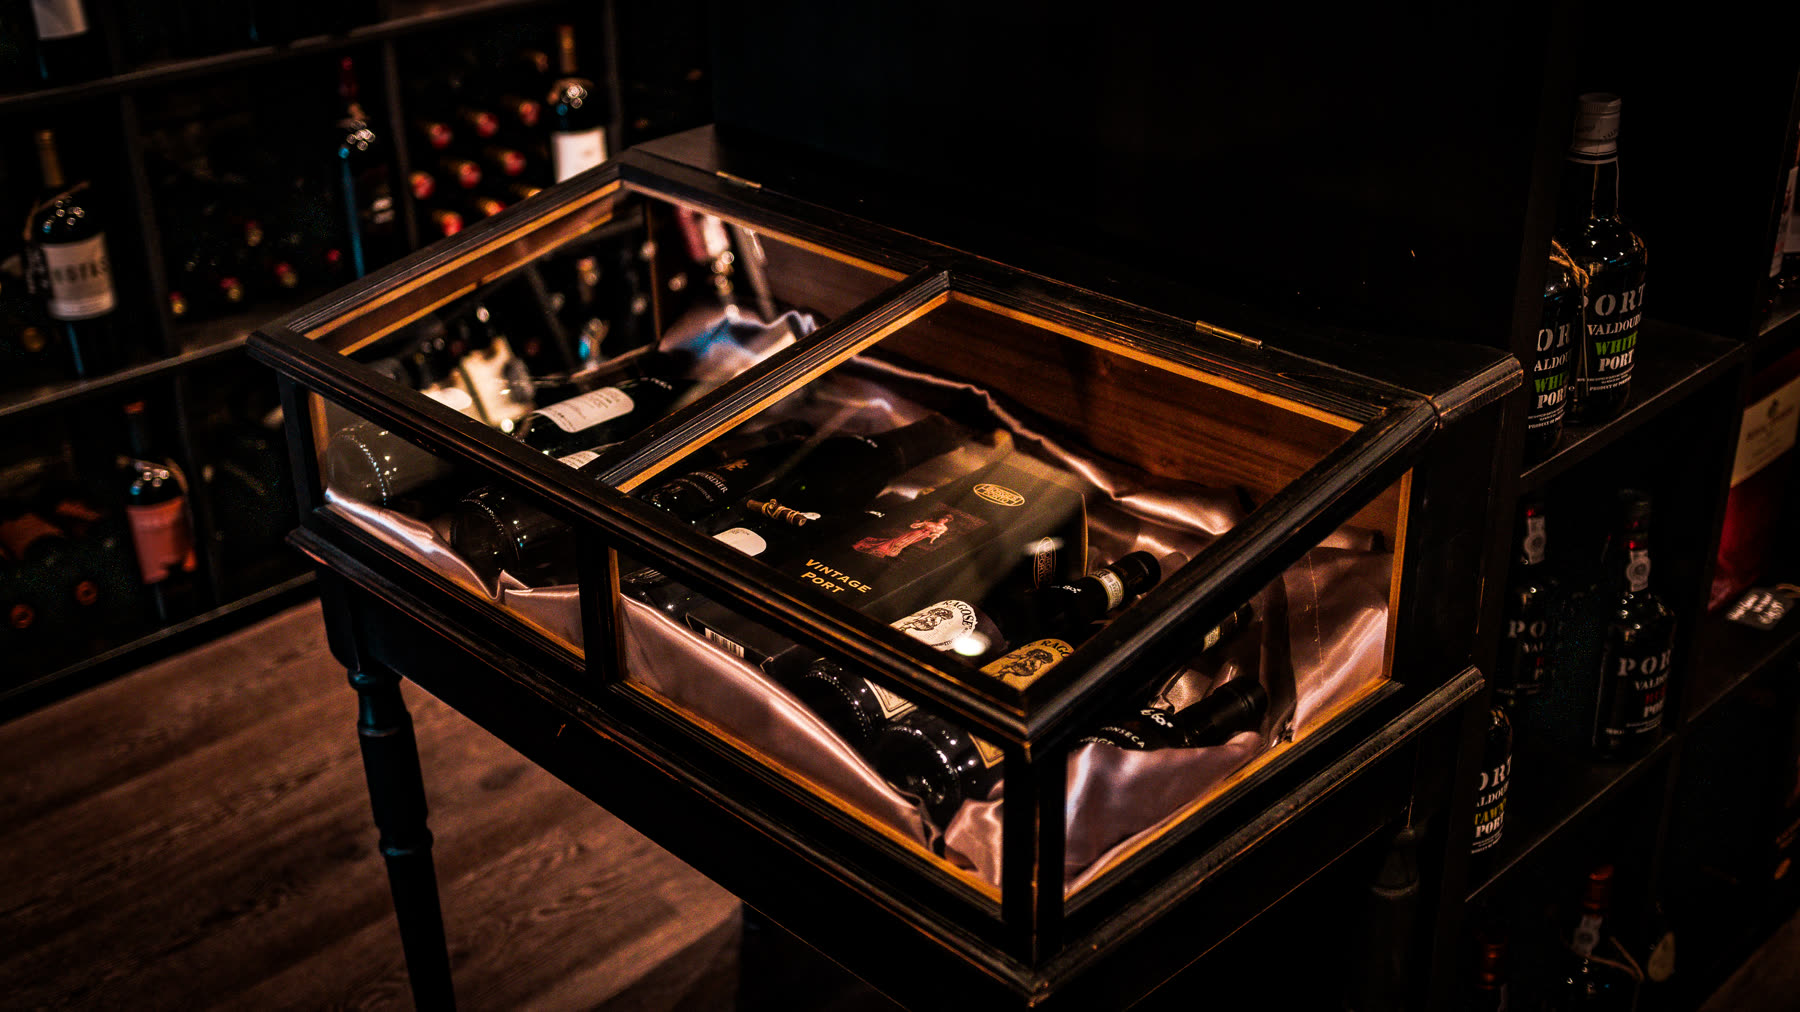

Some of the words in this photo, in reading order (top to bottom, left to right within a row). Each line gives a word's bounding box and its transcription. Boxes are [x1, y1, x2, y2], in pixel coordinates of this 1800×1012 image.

[1536, 322, 1572, 352] OR
[1534, 370, 1569, 393] WHI
[801, 571, 845, 593] PORT
[805, 559, 873, 594] VINTAGE
[943, 600, 973, 630] RAGOSE
[1507, 618, 1548, 639] PO
[1040, 640, 1071, 658] RAGO
[1616, 648, 1671, 677] POR
[1478, 754, 1512, 791] ORT
